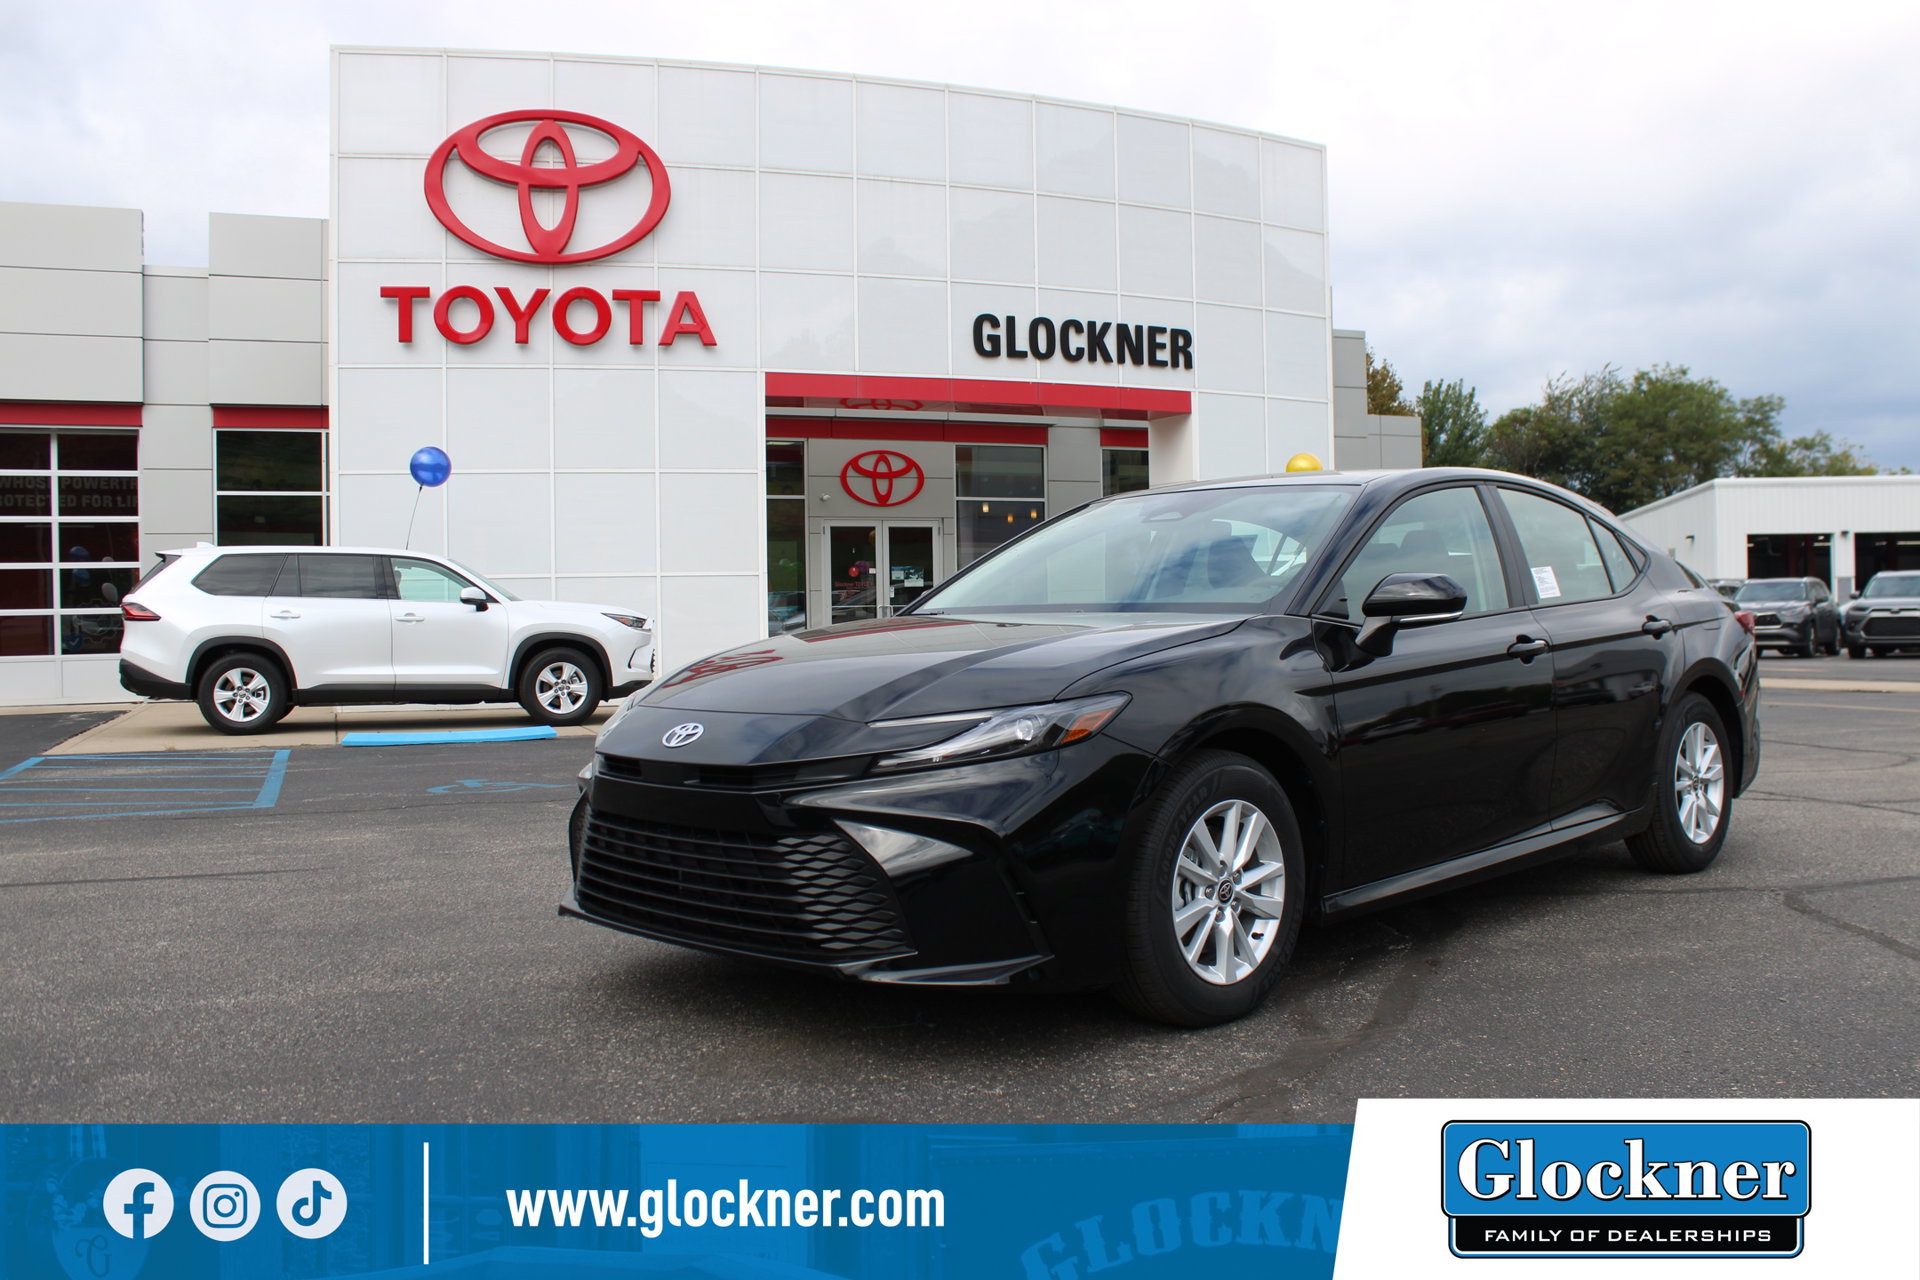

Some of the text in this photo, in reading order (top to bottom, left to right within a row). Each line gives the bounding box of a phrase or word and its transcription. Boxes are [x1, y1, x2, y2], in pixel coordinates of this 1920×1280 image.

[380, 285, 717, 346] TOYOTA
[973, 313, 1193, 369] GLOCKNER
[0, 477, 50, 489] WHOS
[0, 494, 77, 507] OTECED
[82, 495, 113, 507] FOR
